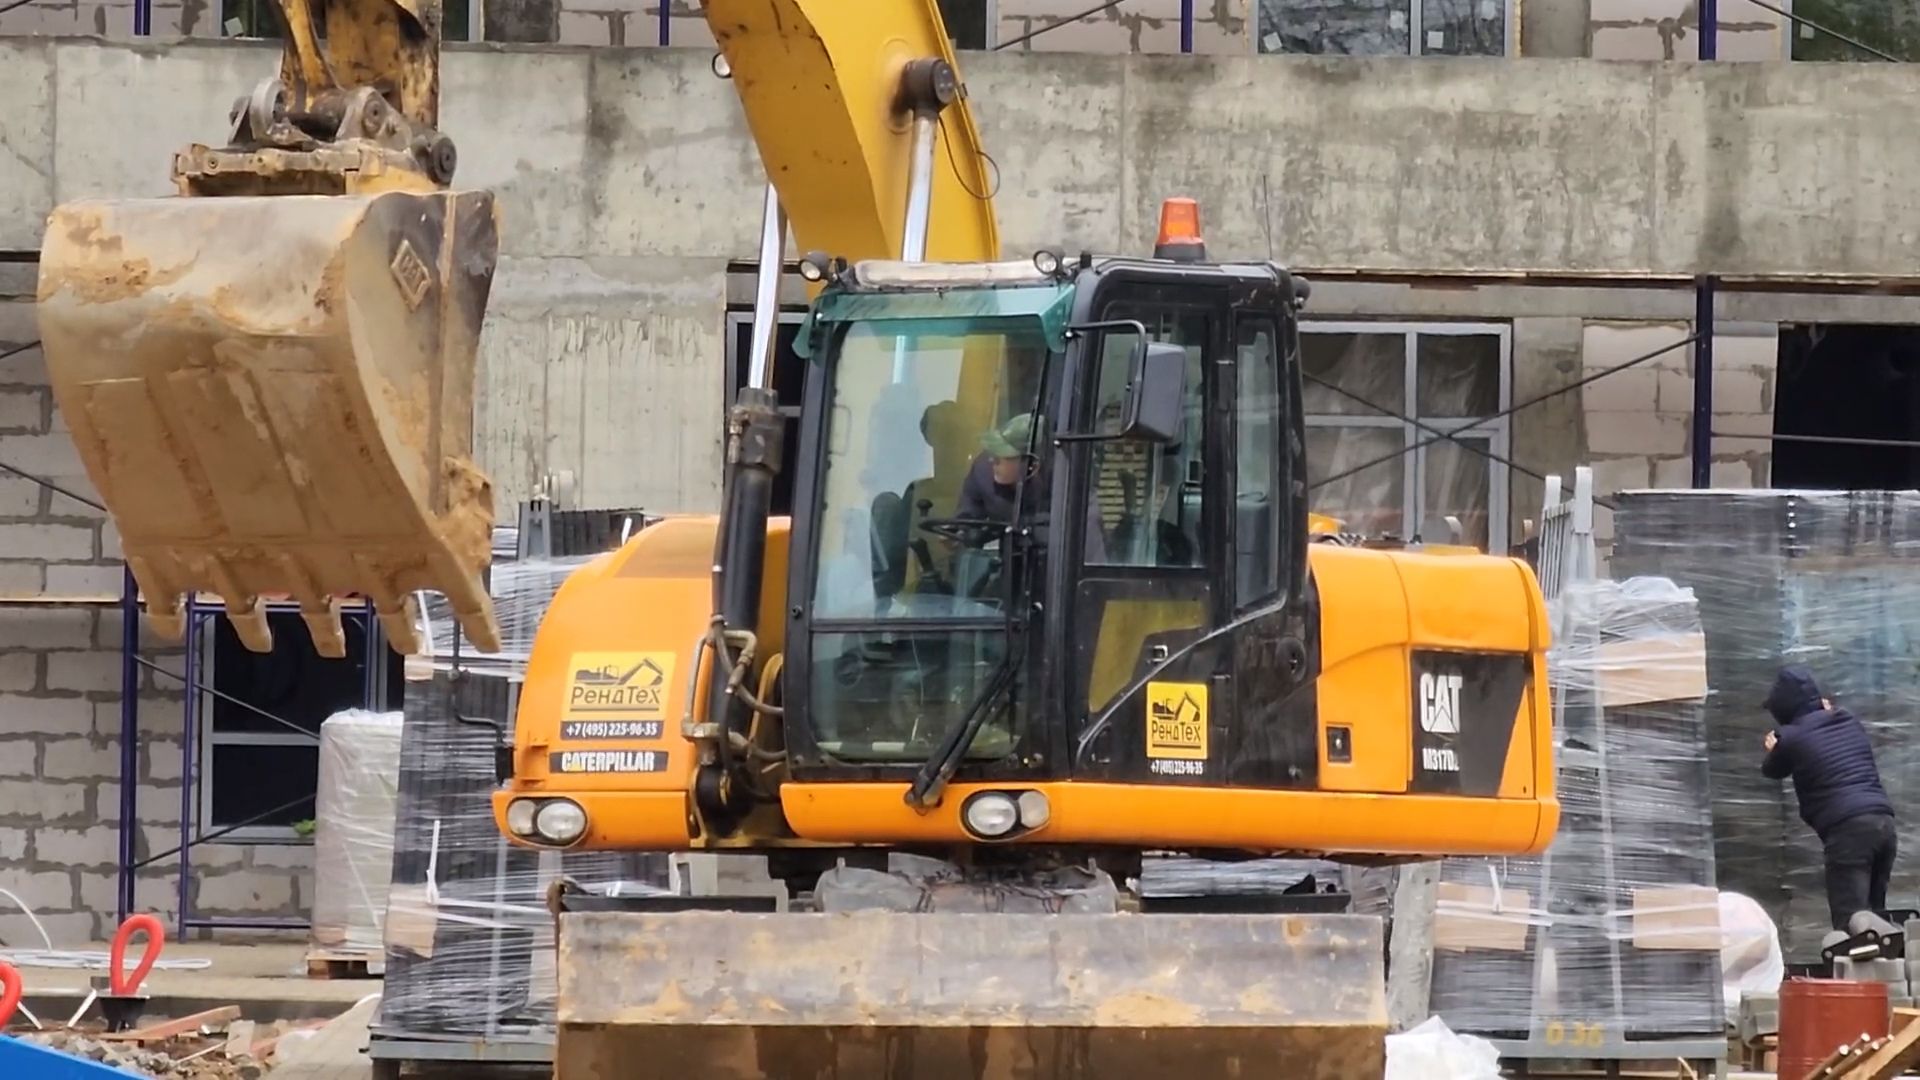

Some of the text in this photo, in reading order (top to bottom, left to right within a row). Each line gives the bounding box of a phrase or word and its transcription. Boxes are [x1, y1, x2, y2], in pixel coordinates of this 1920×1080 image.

[1420, 672, 1463, 733] CAT
[566, 723, 580, 736] +7
[561, 751, 655, 772] CATERPILLAR
